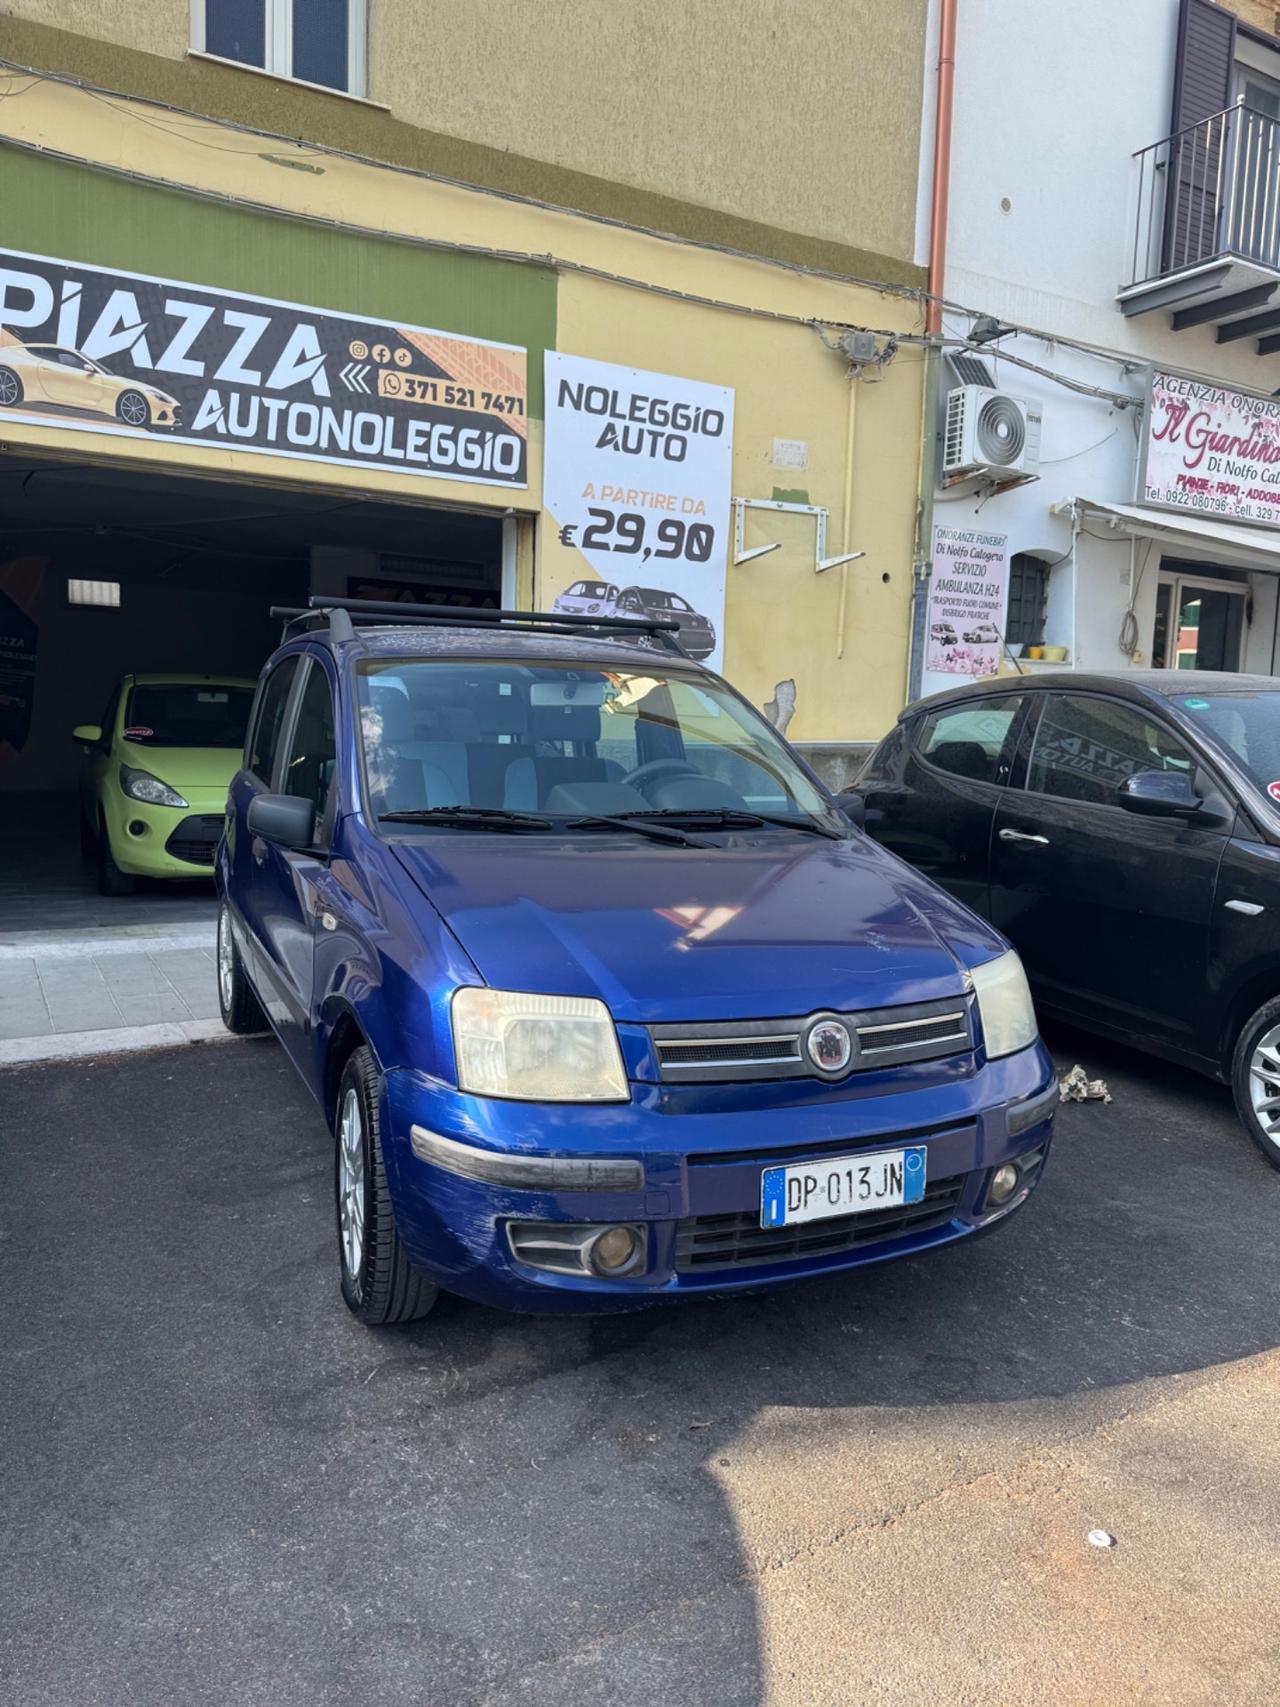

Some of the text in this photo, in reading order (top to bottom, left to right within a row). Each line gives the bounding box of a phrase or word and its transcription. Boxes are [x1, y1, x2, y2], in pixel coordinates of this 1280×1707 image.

[405, 378, 524, 416] 371 521 7471
[557, 379, 725, 437] NOLEGGIO
[1153, 375, 1226, 406] AGENZIA
[191, 388, 521, 475] AUTONOLEGGIO
[595, 422, 688, 462] AUTO
[1207, 456, 1220, 473] Di
[1224, 460, 1258, 481] Nolfo
[581, 482, 706, 516] A PARTIRE DA
[1145, 485, 1162, 500] Tel.
[1166, 489, 1189, 505] 0922
[1192, 495, 1226, 511] 080796
[1234, 504, 1253, 516] cell.
[1256, 506, 1272, 520] 329
[558, 507, 715, 563] € 29,90
[935, 542, 946, 554] Di
[952, 561, 987, 577] SERVIZIO
[935, 579, 1000, 597] AMBULANZA H24
[788, 1175, 817, 1212] DP
